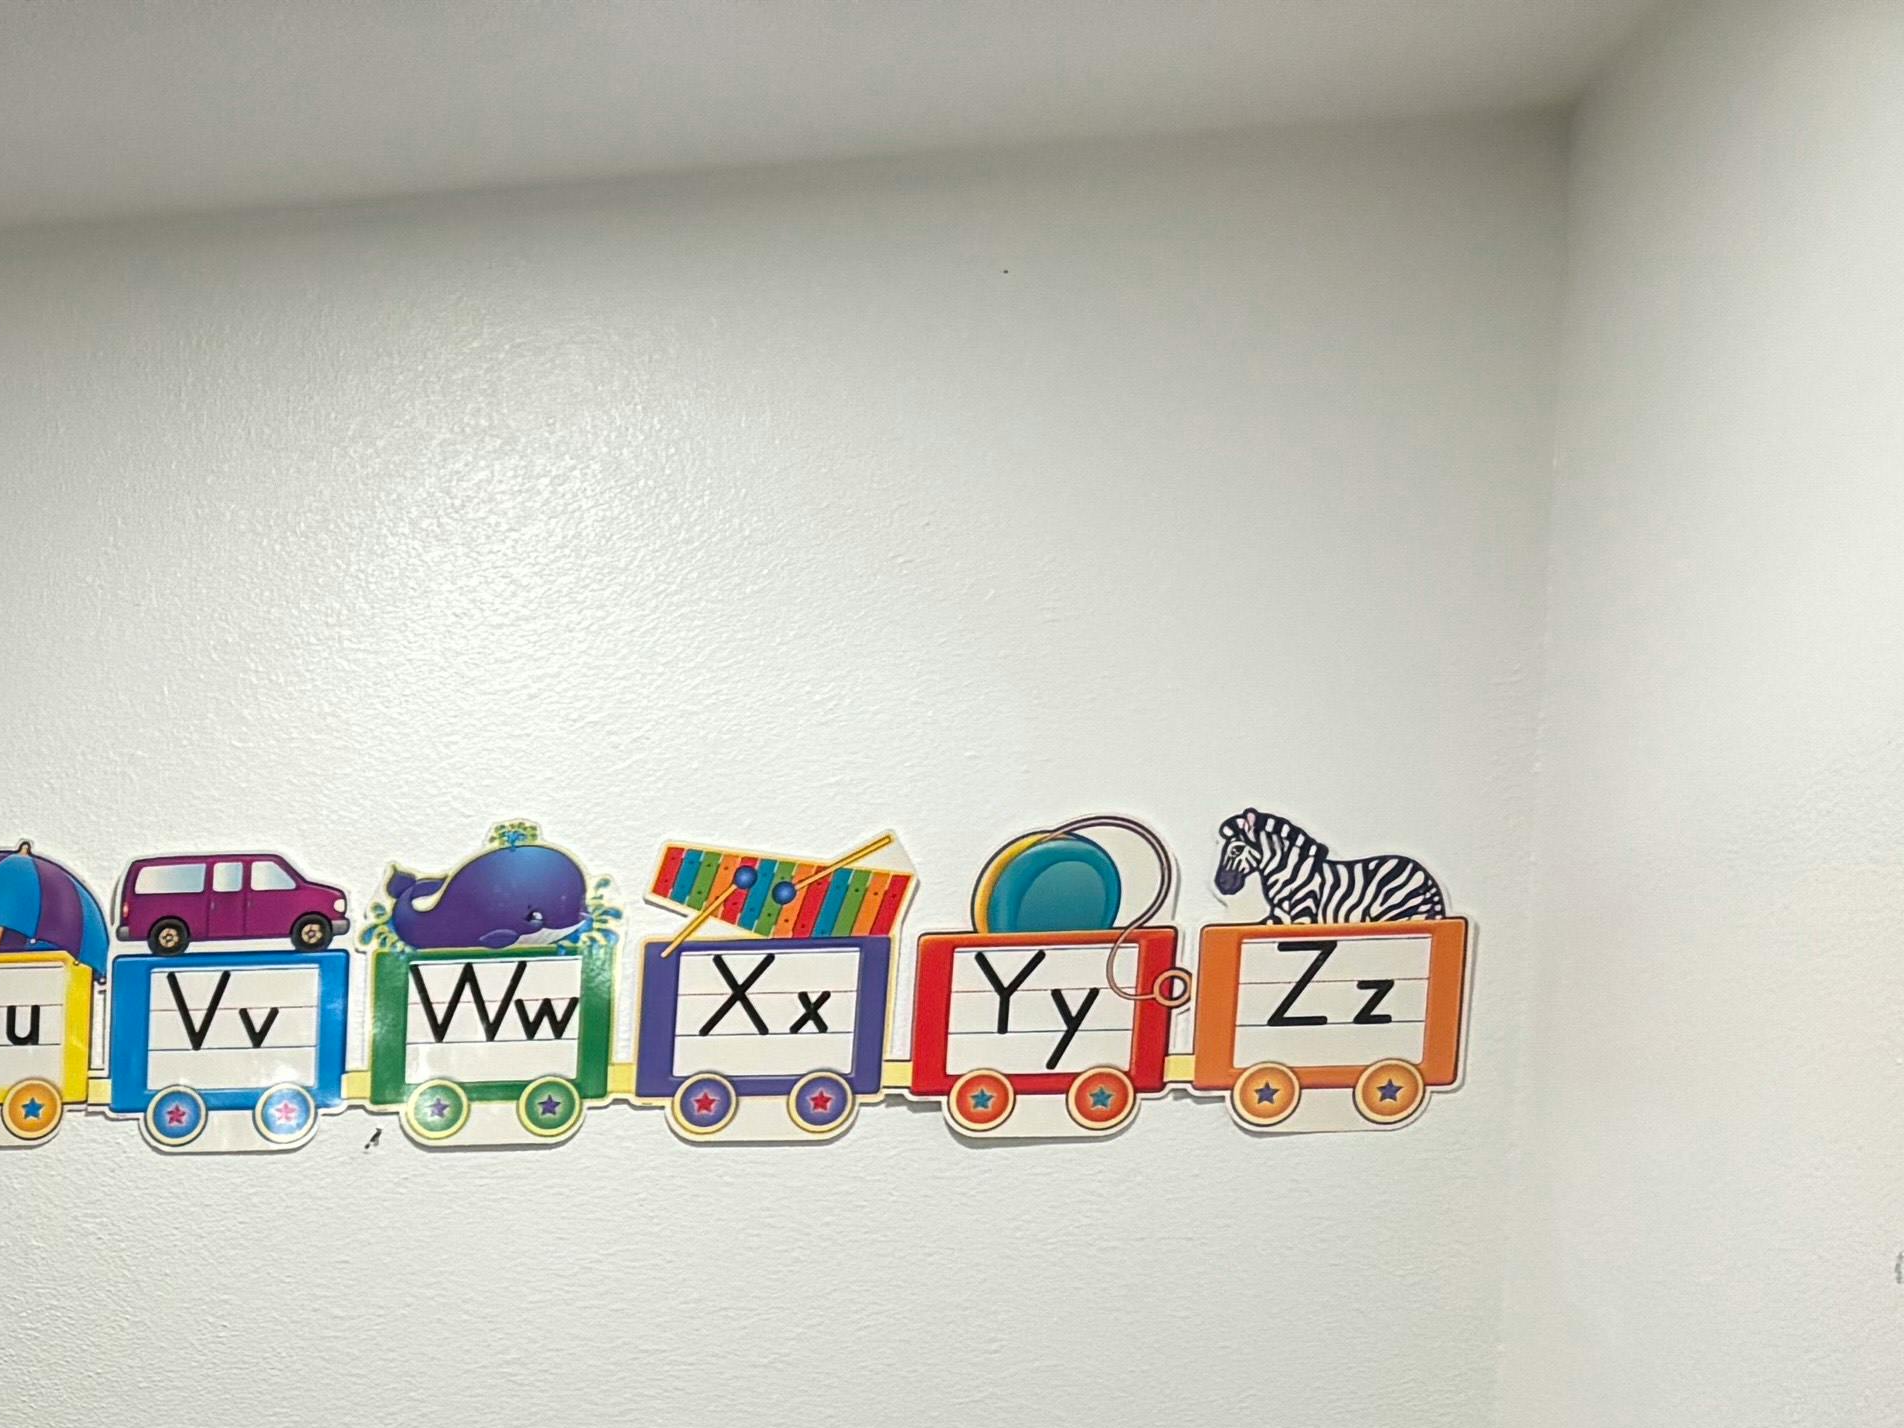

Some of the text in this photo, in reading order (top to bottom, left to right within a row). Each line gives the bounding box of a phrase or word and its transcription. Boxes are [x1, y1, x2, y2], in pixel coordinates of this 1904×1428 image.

[166, 969, 279, 1051] Vv
[408, 959, 580, 1043] Ww
[698, 952, 831, 1037] Xx
[974, 949, 1100, 1070] Yy
[1266, 939, 1395, 1027] Zz
